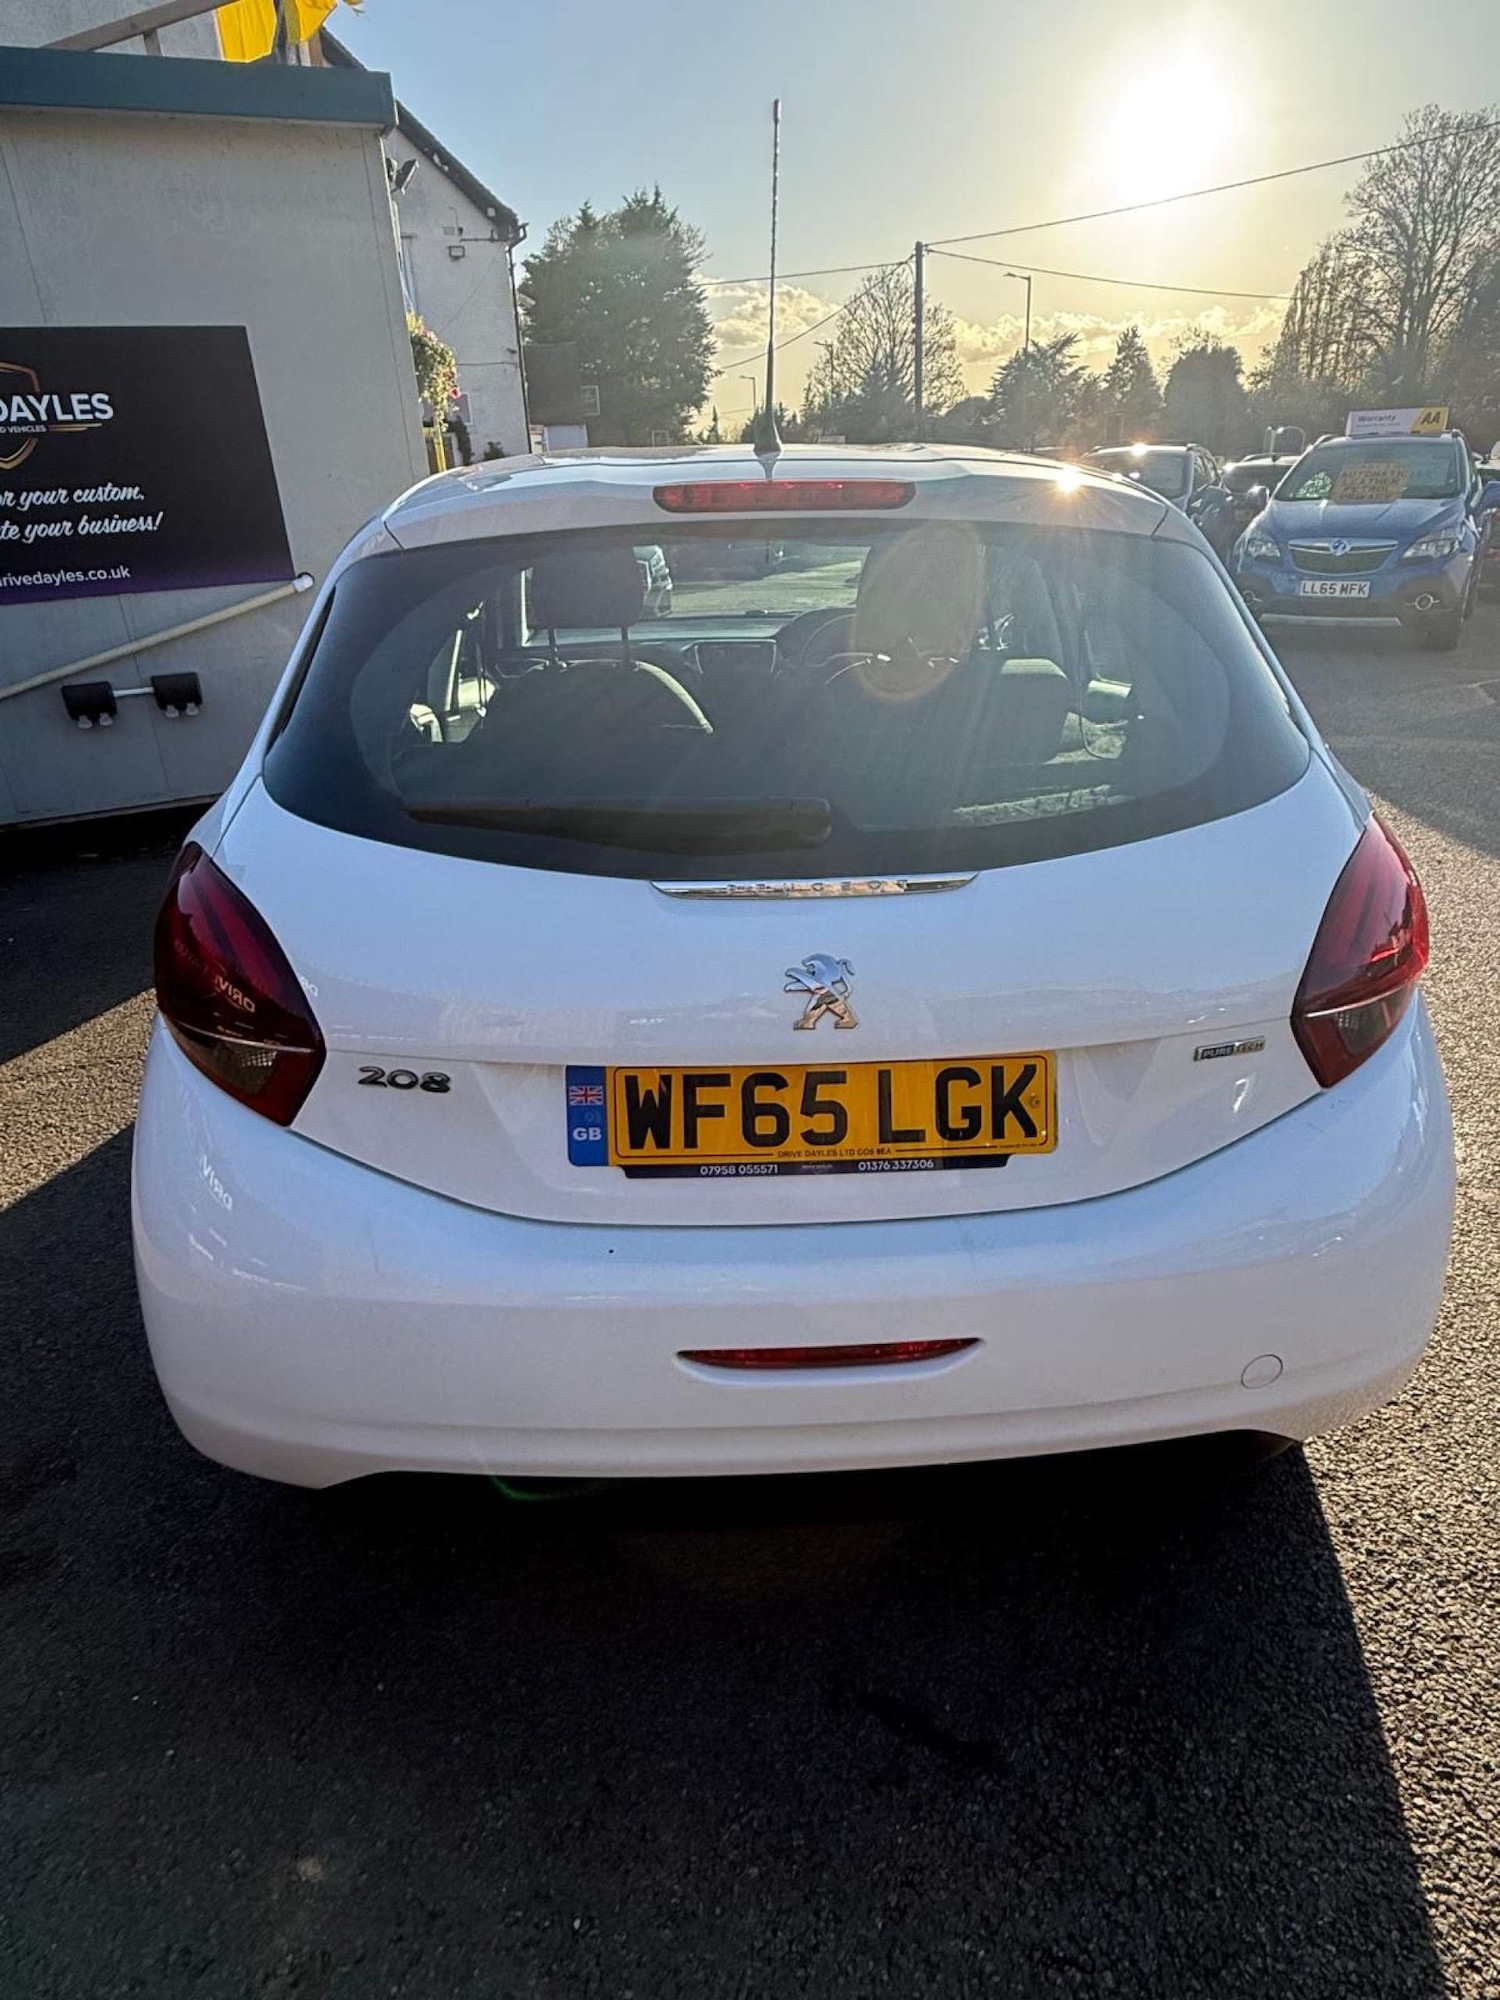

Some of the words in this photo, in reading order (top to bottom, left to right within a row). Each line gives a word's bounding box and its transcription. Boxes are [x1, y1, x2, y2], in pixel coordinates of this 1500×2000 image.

[1420, 410, 1441, 424] AA
[7, 425, 47, 434] VEHICLES
[16, 488, 69, 511] your
[73, 482, 145, 502] custom.
[22, 520, 74, 544] your
[77, 511, 164, 535] business!
[1302, 583, 1338, 595] LL65
[1340, 583, 1368, 596] MFK
[358, 1066, 450, 1093] 208
[624, 1071, 848, 1149] WF65
[878, 1064, 1038, 1146] LGK
[573, 1127, 602, 1141] GB
[700, 1165, 736, 1176] 07958
[738, 1164, 779, 1175] 055571
[858, 1161, 891, 1171] 01376
[892, 1159, 935, 1170] 337306
